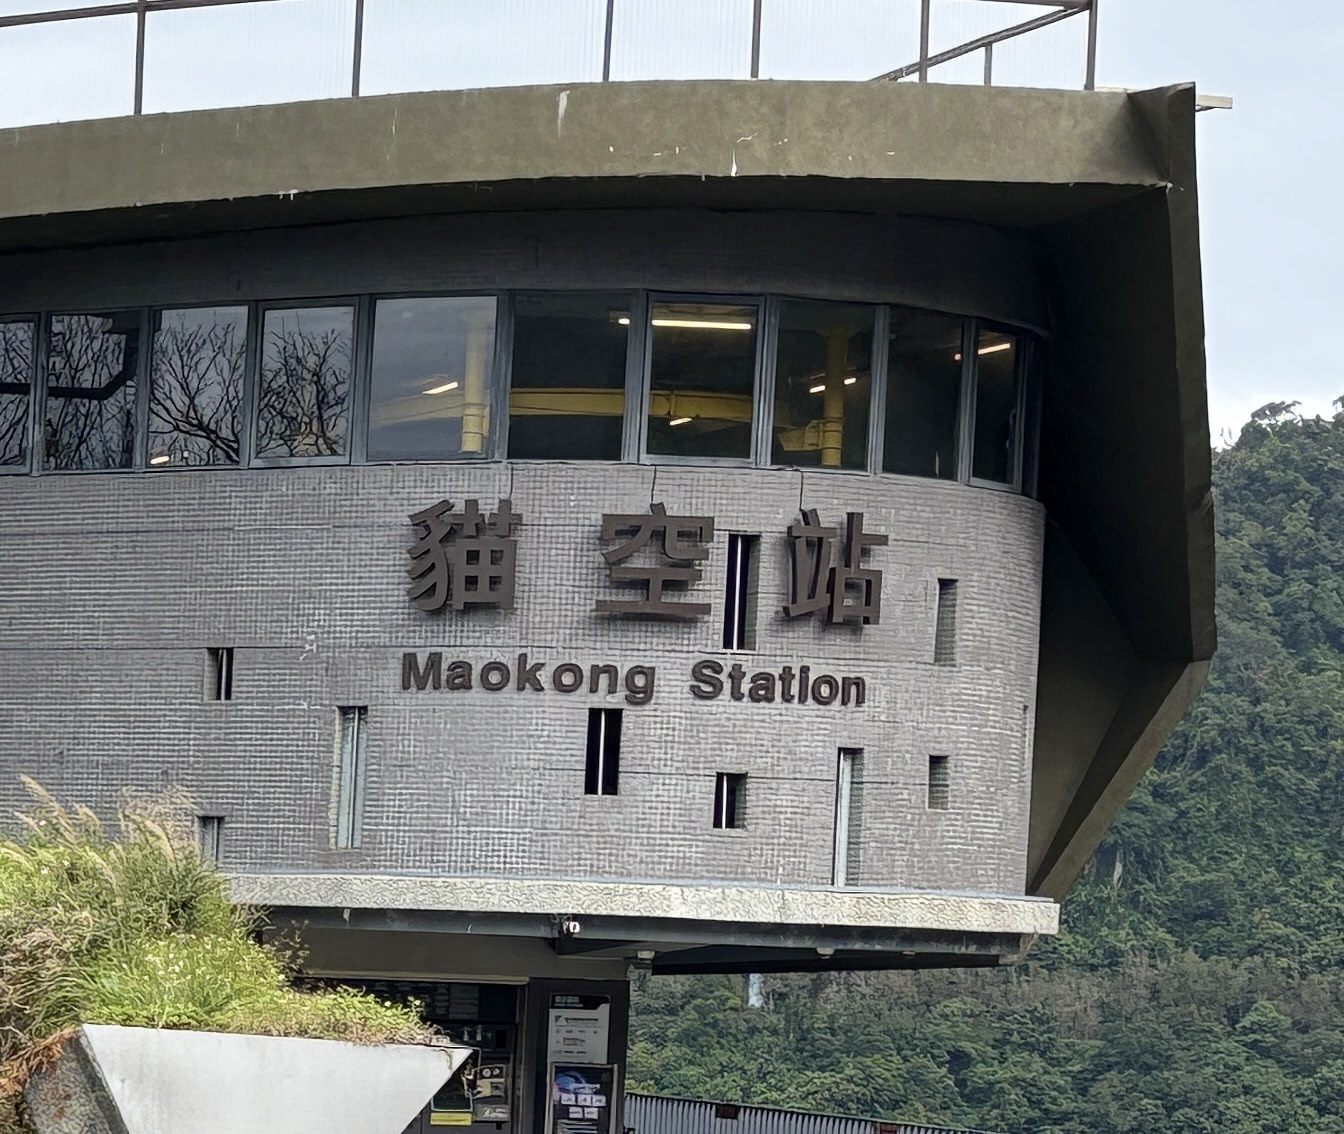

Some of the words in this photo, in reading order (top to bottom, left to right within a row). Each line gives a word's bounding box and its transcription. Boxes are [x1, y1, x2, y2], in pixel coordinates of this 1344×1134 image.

[406, 499, 889, 625] 貓空站
[401, 652, 656, 706] Maokong
[689, 659, 866, 706] Station
